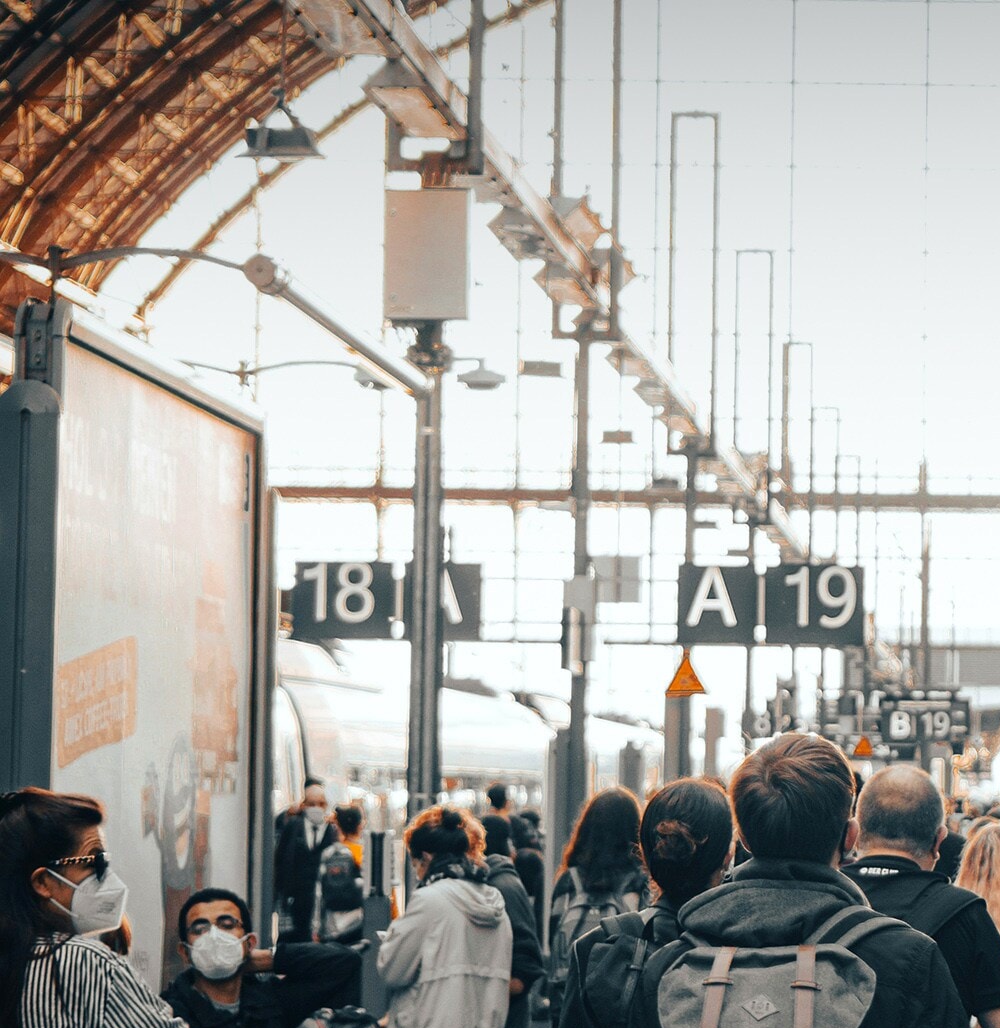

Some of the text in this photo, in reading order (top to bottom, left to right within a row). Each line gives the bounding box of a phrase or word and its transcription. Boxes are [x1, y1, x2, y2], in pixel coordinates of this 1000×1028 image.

[303, 563, 376, 623] 18
[685, 565, 857, 629] A 19
[889, 710, 951, 740] B 19
